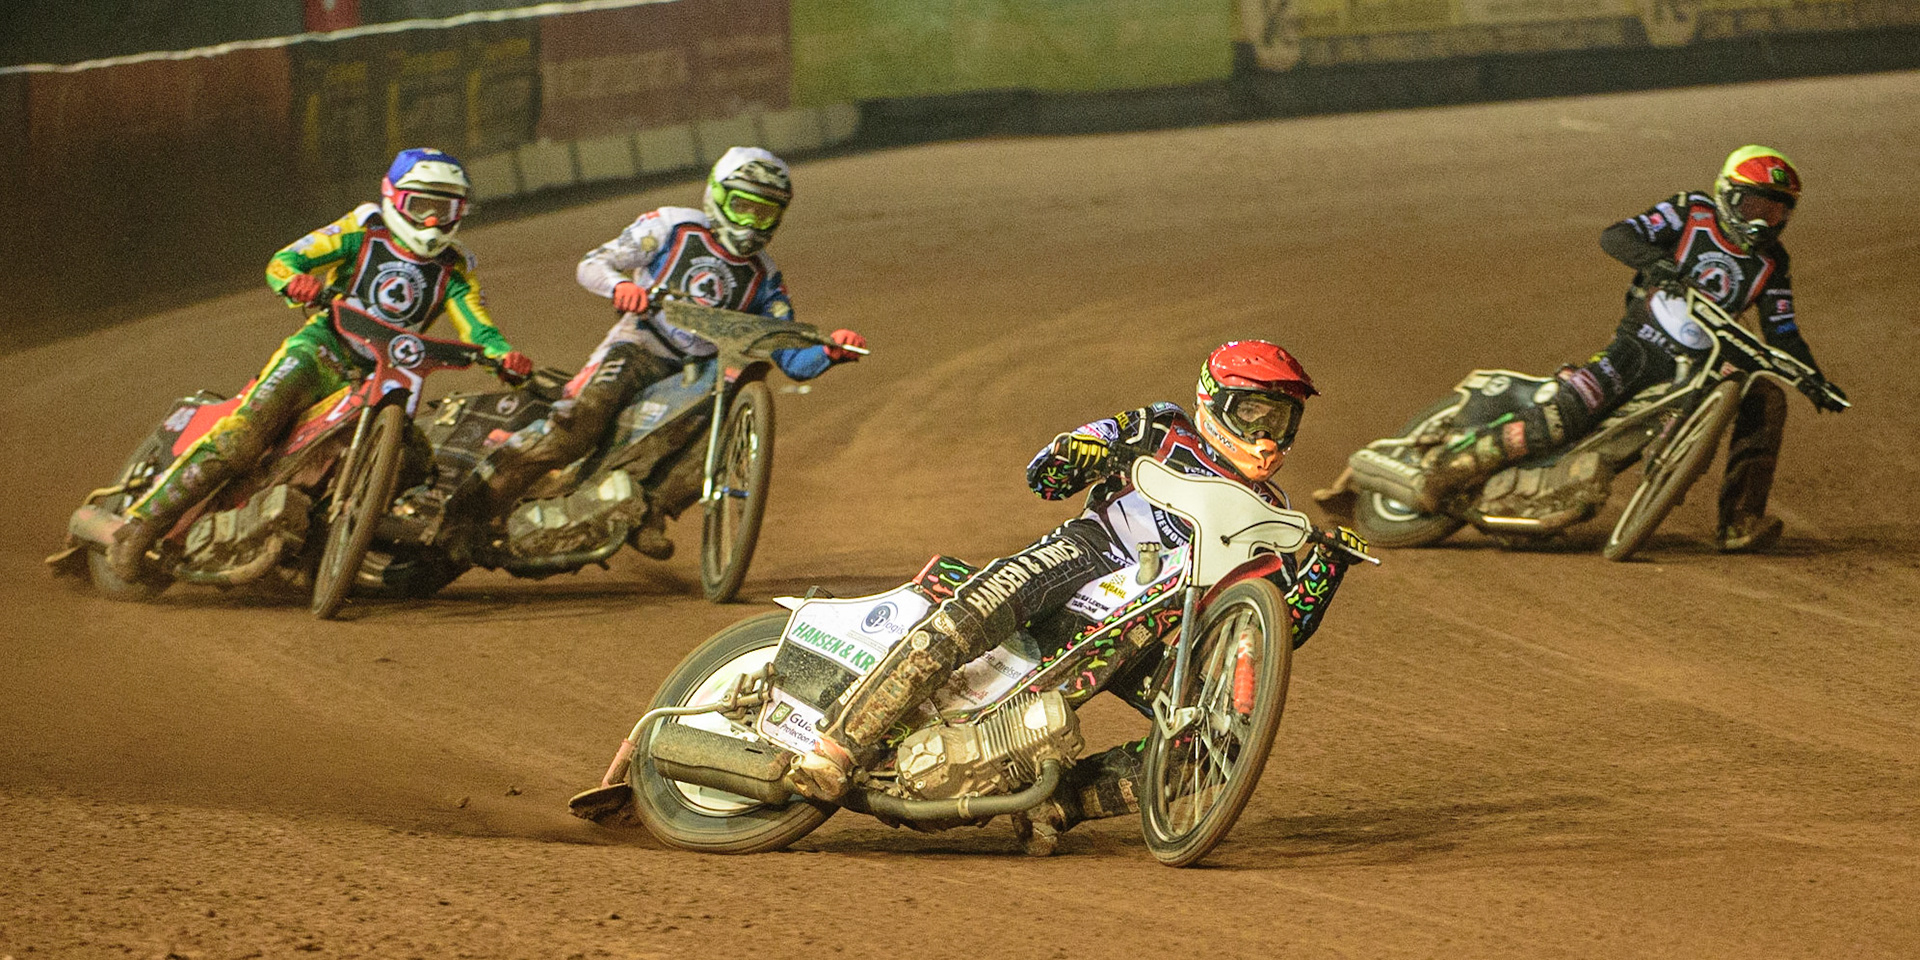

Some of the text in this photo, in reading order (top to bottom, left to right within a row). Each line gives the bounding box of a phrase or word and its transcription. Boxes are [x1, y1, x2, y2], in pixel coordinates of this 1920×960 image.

[966, 561, 1031, 618] HANSEN
[1018, 556, 1043, 575] &
[791, 622, 845, 654] HANSEN
[839, 644, 855, 659] &
[780, 723, 810, 744] Protection
